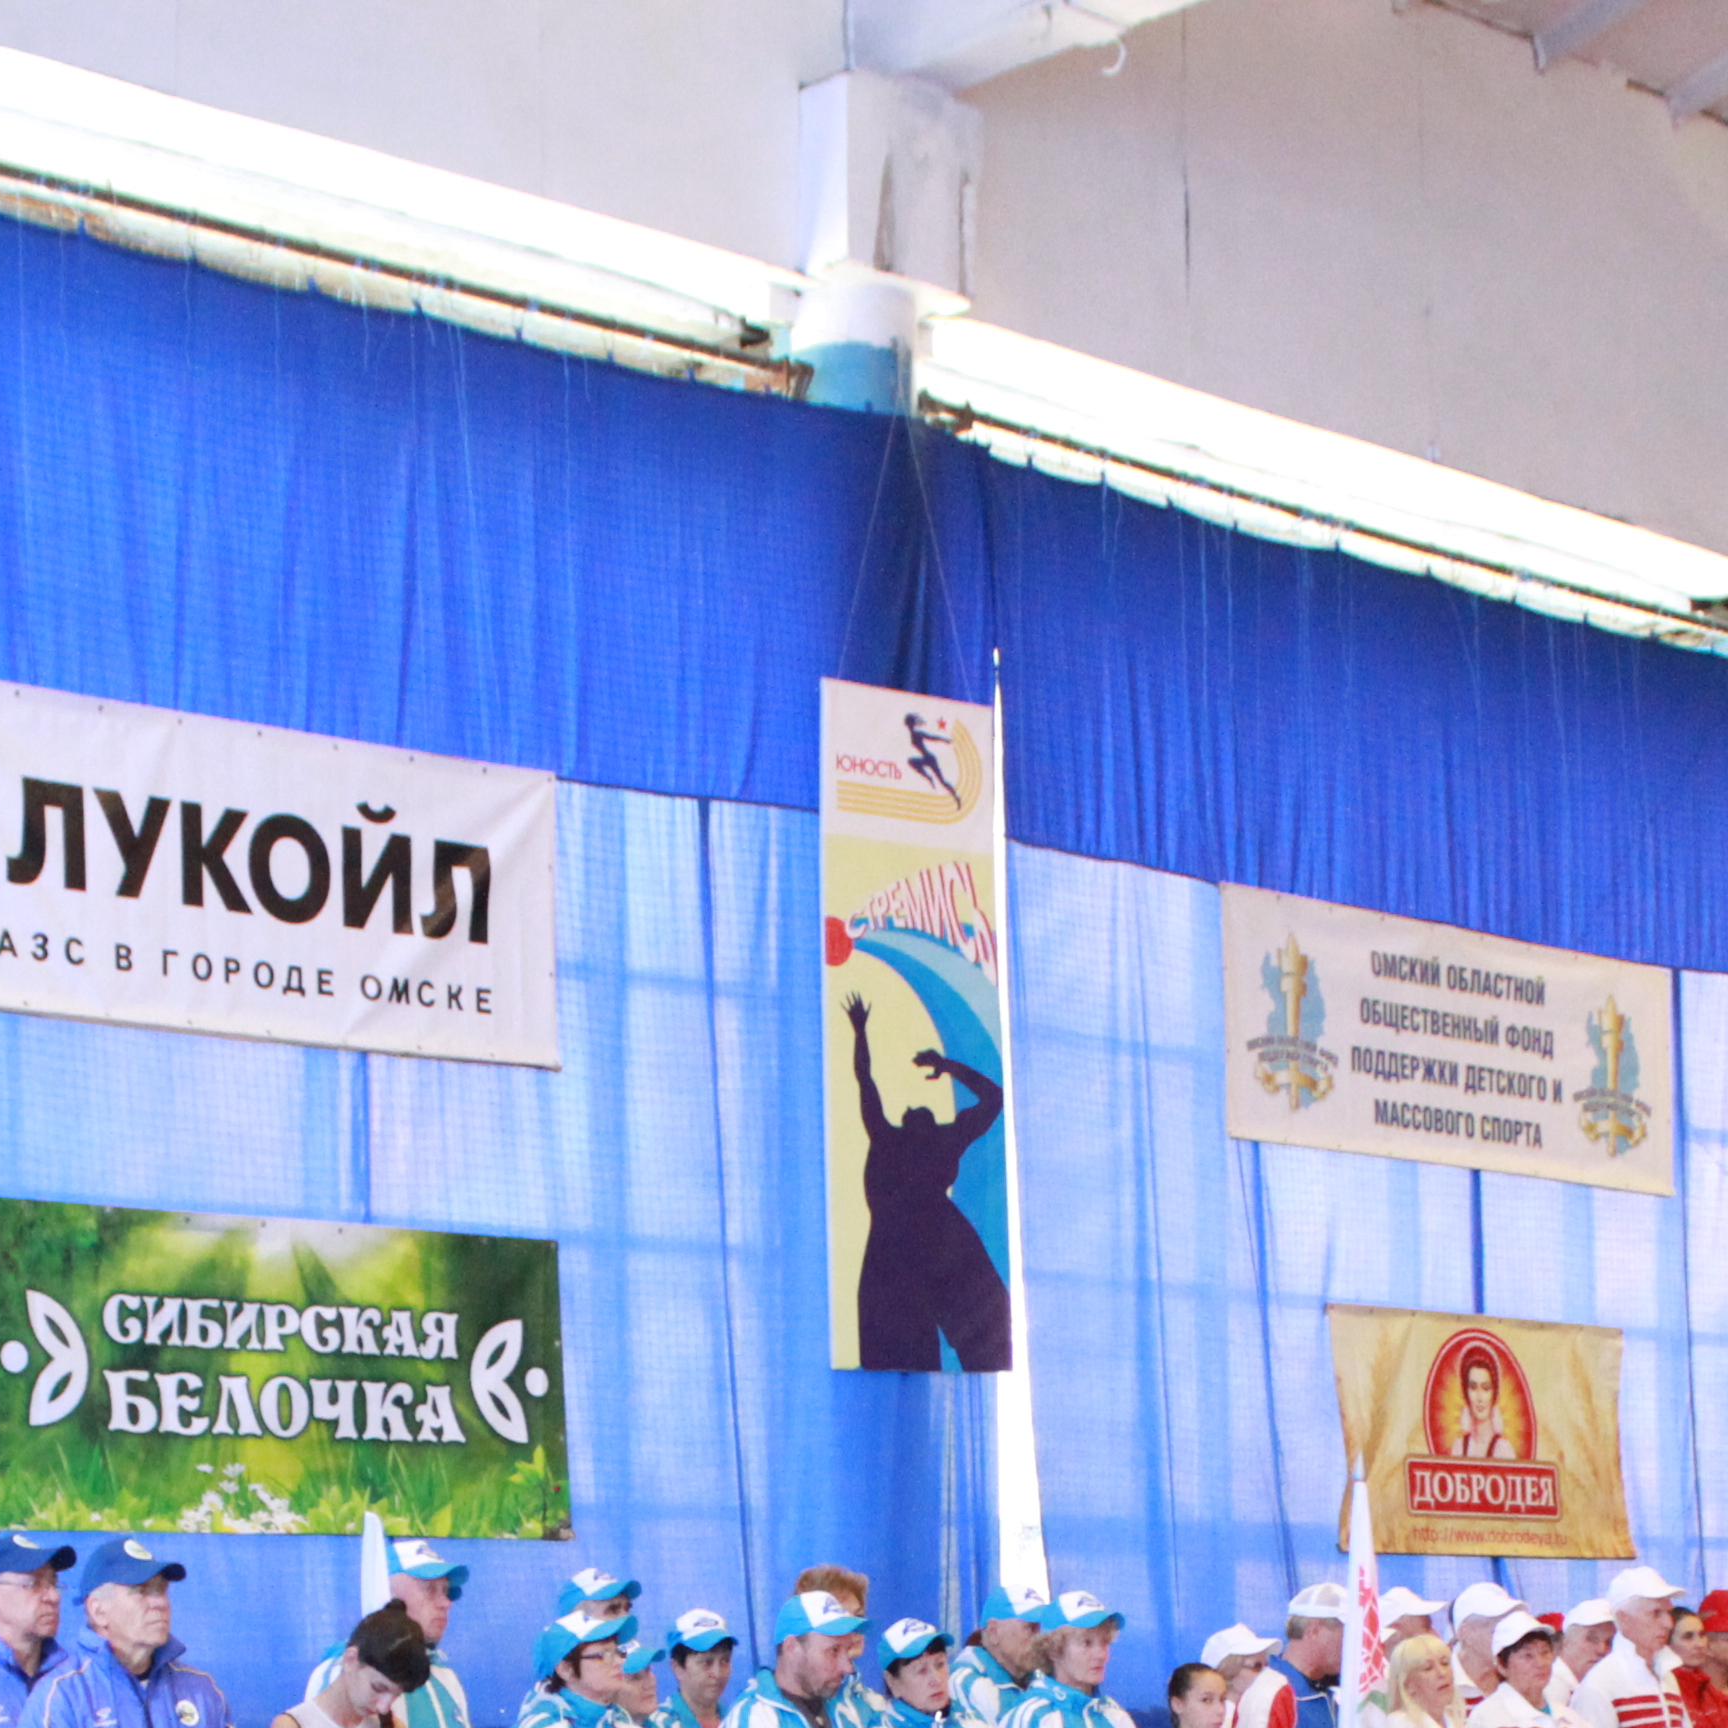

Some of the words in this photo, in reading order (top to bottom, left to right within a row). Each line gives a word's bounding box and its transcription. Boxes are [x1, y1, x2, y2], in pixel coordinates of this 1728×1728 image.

[835, 754, 902, 780] ЮНОСТЬ
[6, 776, 491, 945] ЛУКОЙЛ
[115, 944, 134, 972] В
[161, 950, 335, 999] ГОРОДЕ
[360, 975, 494, 1015] ОМСКЕ
[1370, 950, 1441, 988] ОМСКИЙ
[1446, 968, 1546, 1006] ОБЛАСТНОЙ
[1359, 998, 1500, 1046] ОБЩЕСТВЕННЫЙ
[1505, 1028, 1555, 1060] ФОНД
[1351, 1046, 1460, 1088] ПОДДЕРЖКИ
[1464, 1063, 1546, 1102] ДЕТСКОГО
[1552, 1079, 1562, 1104] И
[1374, 1098, 1476, 1137] МАССОВОГО
[1480, 1115, 1544, 1148] СПОРТА
[102, 1293, 460, 1361] СИБИРСКАЯ
[102, 1368, 468, 1445] БЕЛОЧКА
[1413, 1470, 1556, 1512] ДОБРОДЕЯ
